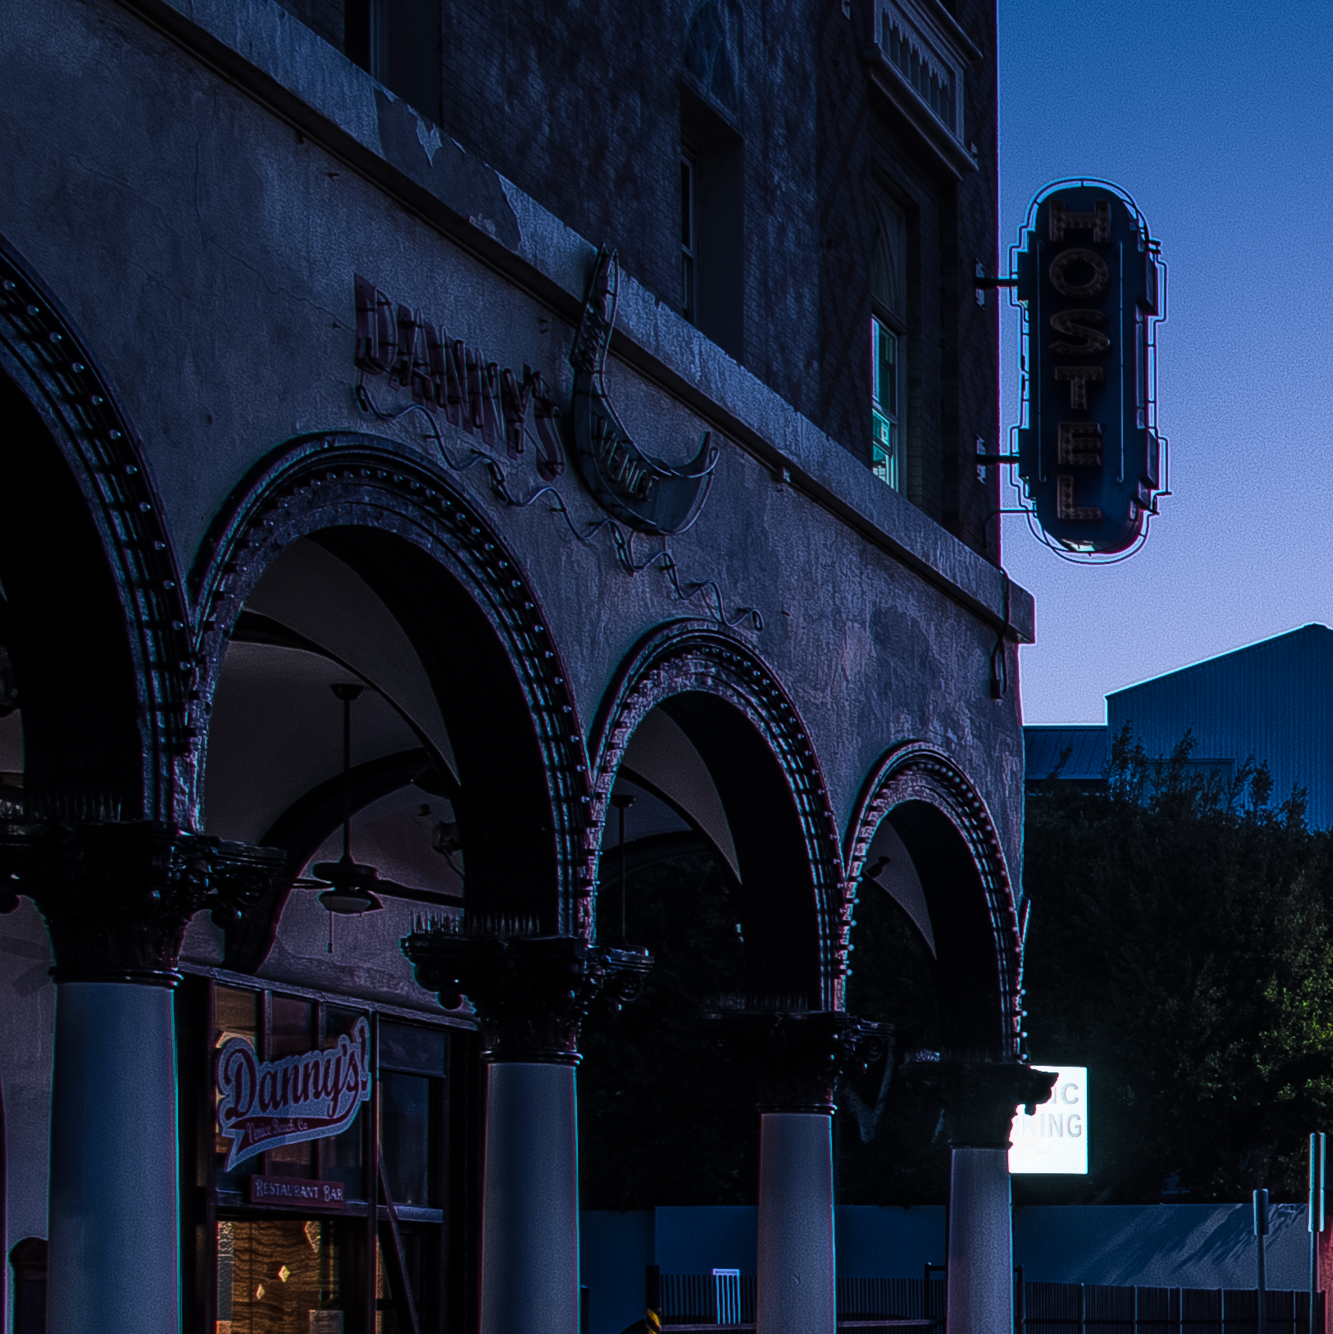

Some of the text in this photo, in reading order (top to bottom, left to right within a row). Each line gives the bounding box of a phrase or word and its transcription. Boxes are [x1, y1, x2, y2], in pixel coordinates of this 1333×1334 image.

[1048, 200, 1111, 520] HOSTEL
[273, 1118, 296, 1135] Beach
[1013, 1113, 1082, 1138] KING
